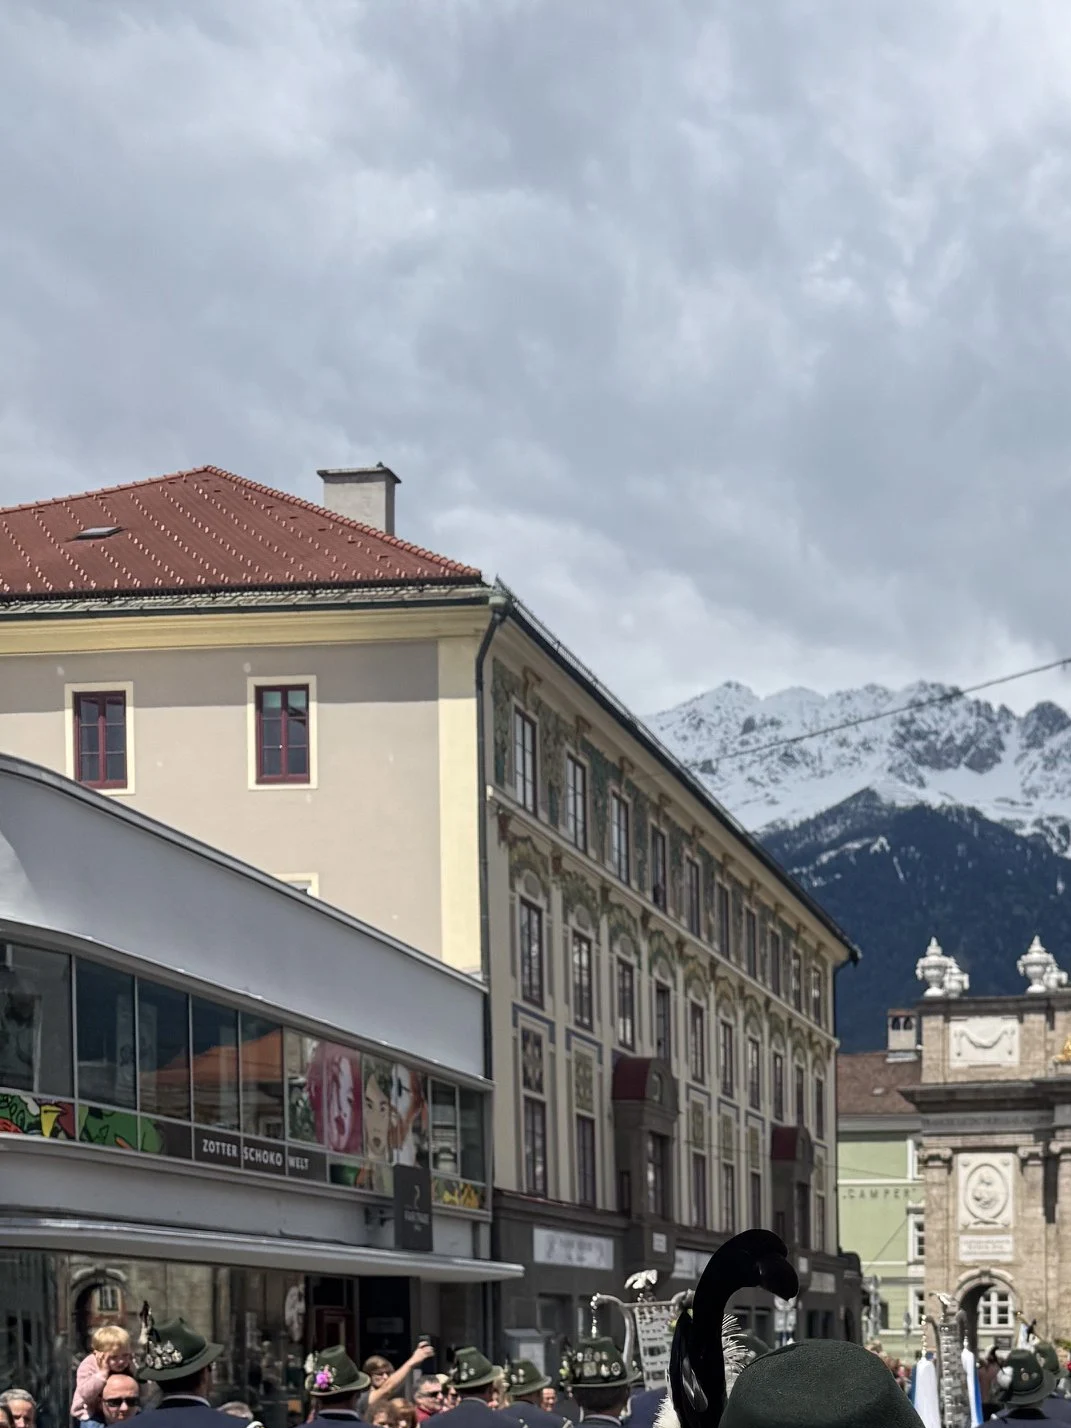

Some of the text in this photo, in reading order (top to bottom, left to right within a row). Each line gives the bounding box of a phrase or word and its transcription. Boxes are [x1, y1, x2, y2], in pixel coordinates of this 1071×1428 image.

[202, 1139, 310, 1170] ZOTTER SCHOKO WELT
